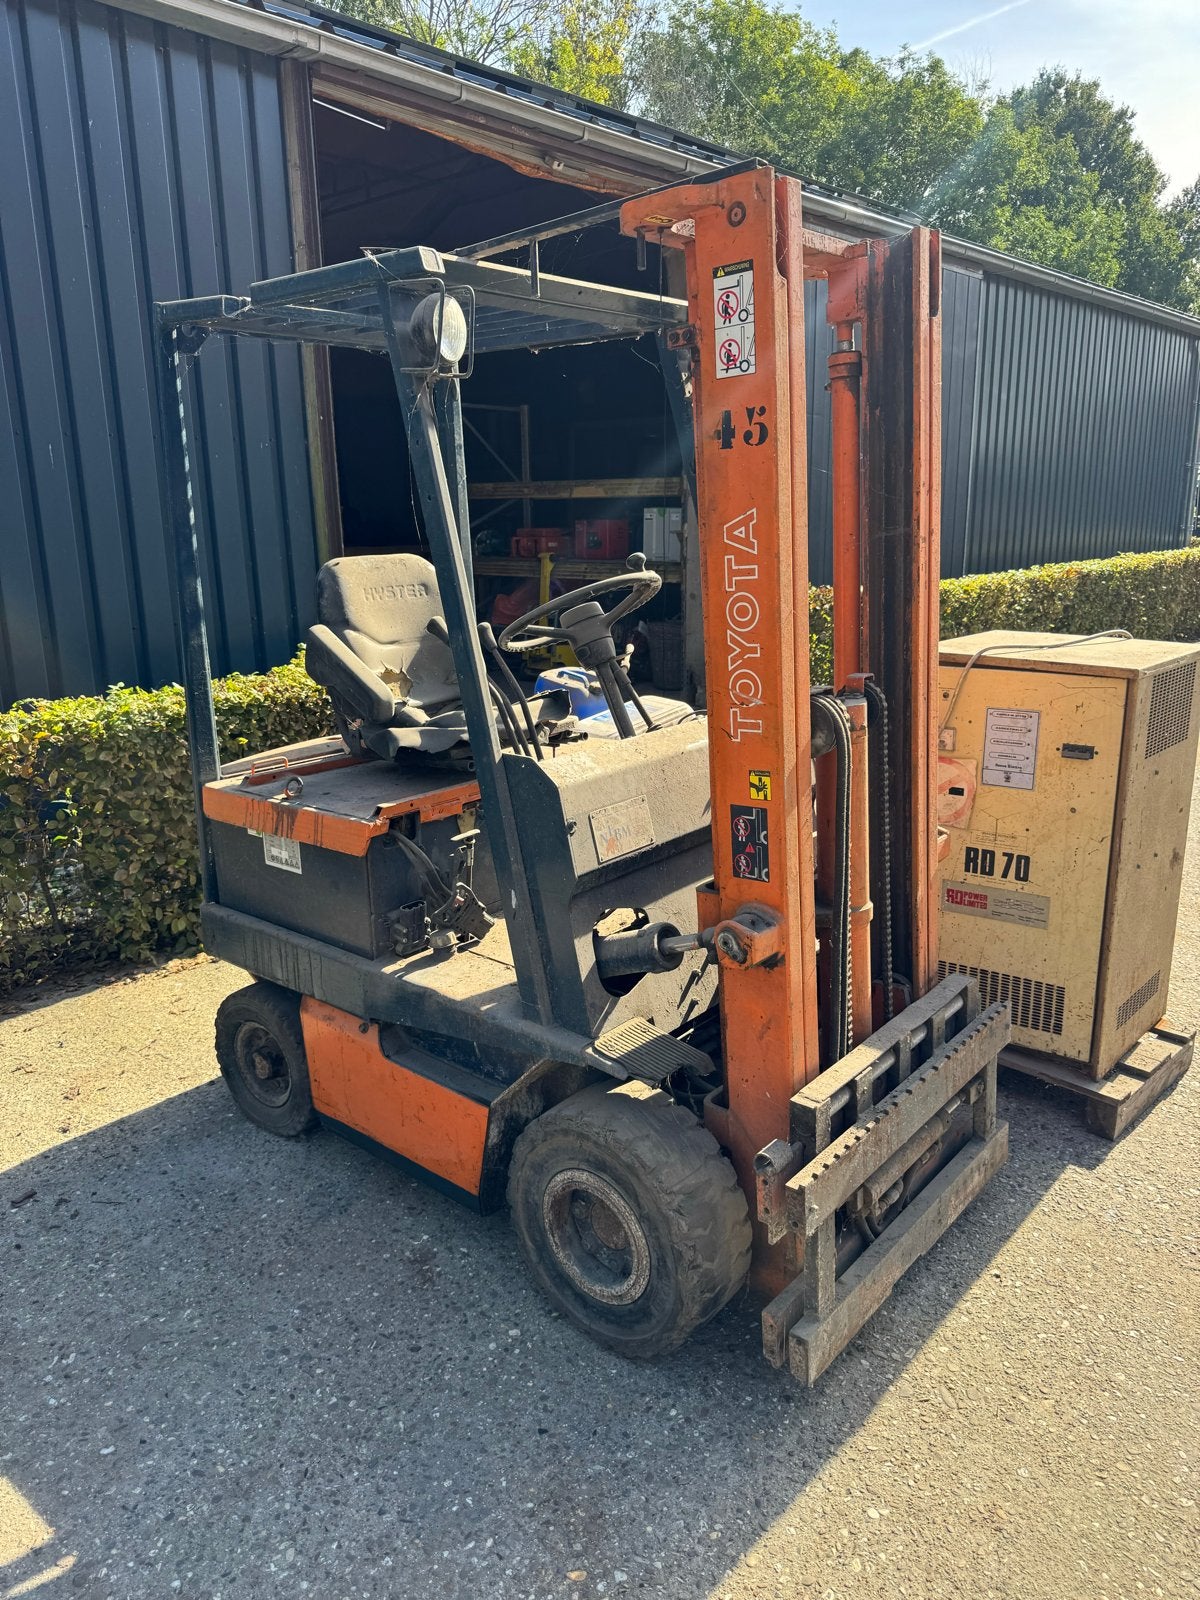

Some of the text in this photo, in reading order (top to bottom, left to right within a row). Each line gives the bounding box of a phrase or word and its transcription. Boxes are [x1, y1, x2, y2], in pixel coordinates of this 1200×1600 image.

[714, 406, 769, 450] 45
[363, 583, 429, 602] HYSTER
[723, 507, 764, 743] TOYOTA
[964, 846, 995, 877] RD
[1001, 851, 1031, 882] 70
[963, 891, 988, 901] POWER
[963, 899, 988, 910] LIMITED
